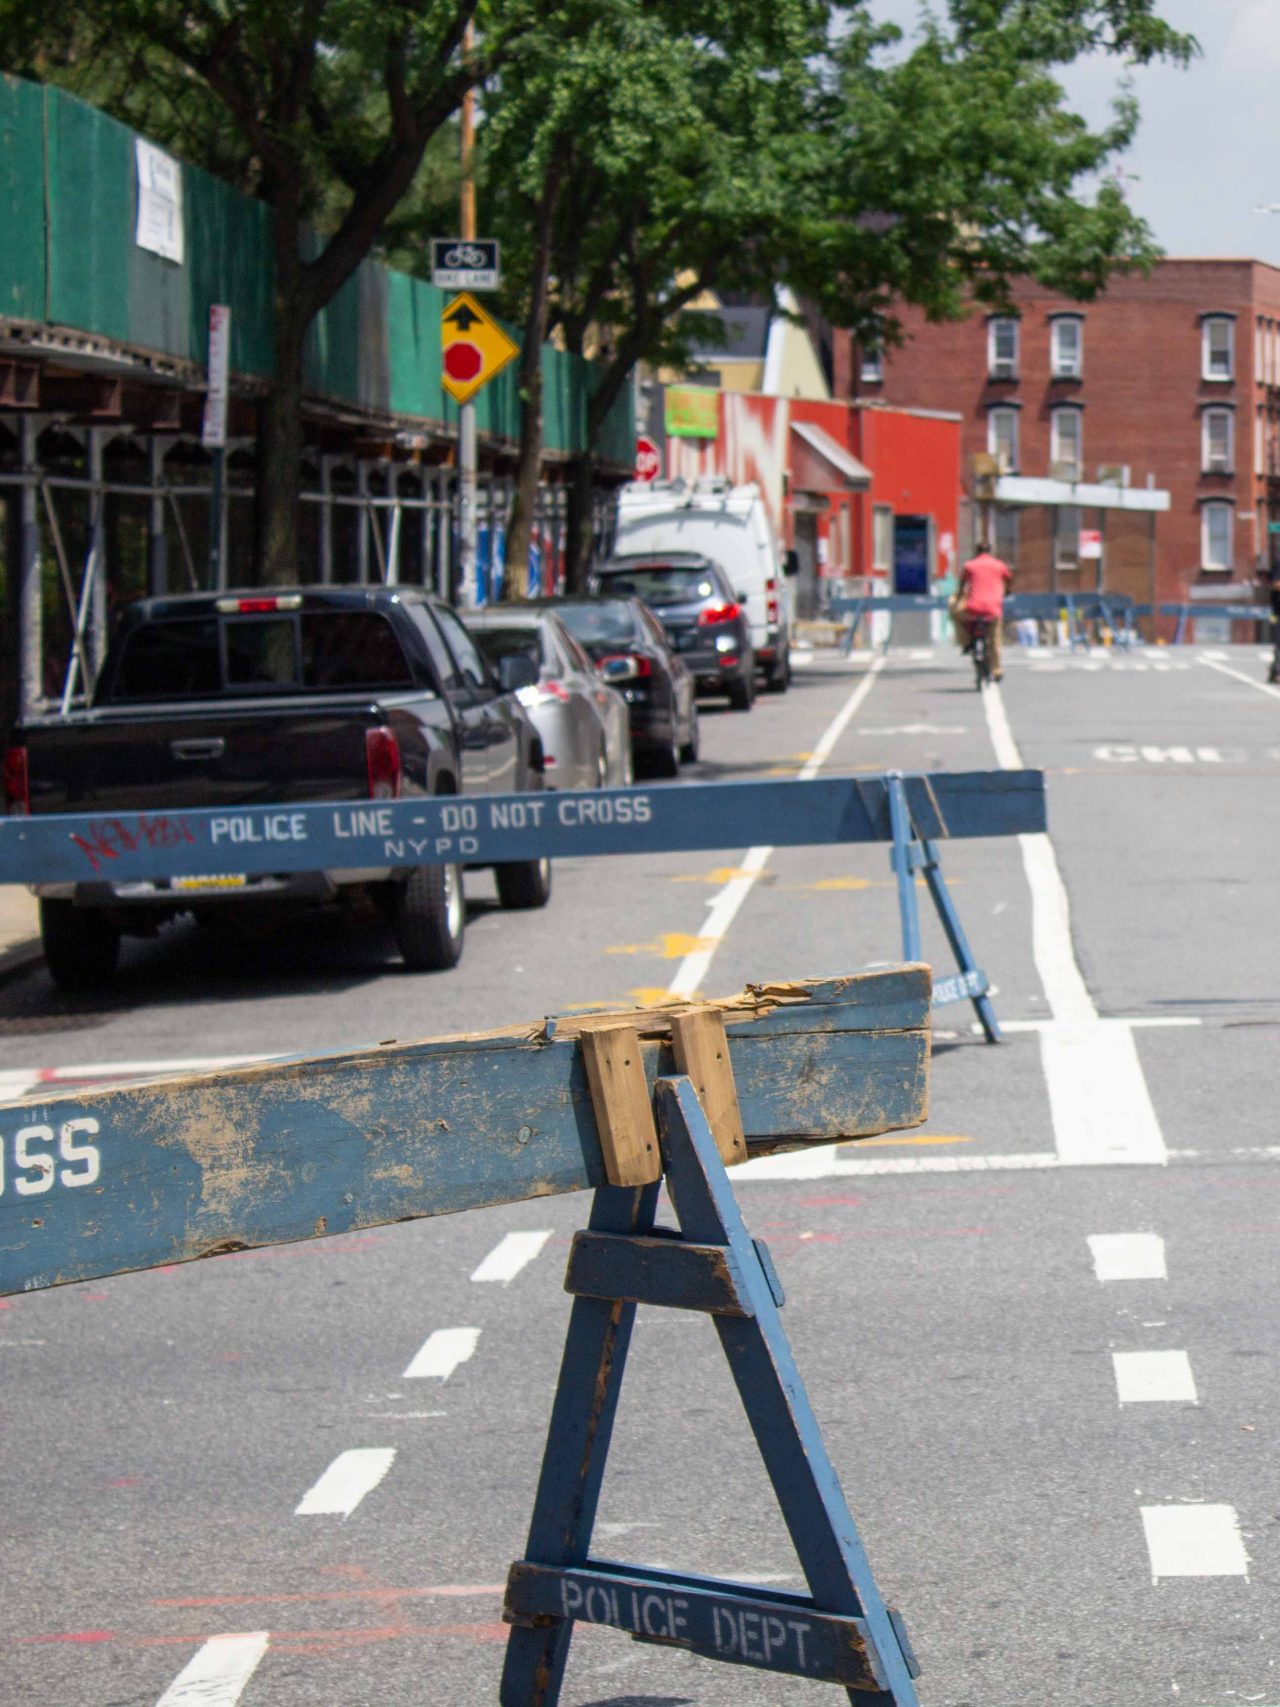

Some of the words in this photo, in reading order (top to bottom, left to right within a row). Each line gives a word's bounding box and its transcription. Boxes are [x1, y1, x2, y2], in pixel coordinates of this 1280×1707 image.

[211, 814, 306, 844] POLICE
[333, 809, 393, 838] LINE
[441, 804, 477, 832] DO
[491, 802, 544, 829] NOT
[558, 797, 652, 826] CROSS
[384, 837, 479, 858] NYPD
[0, 1117, 100, 1196] SS
[560, 1578, 691, 1642] POLICE
